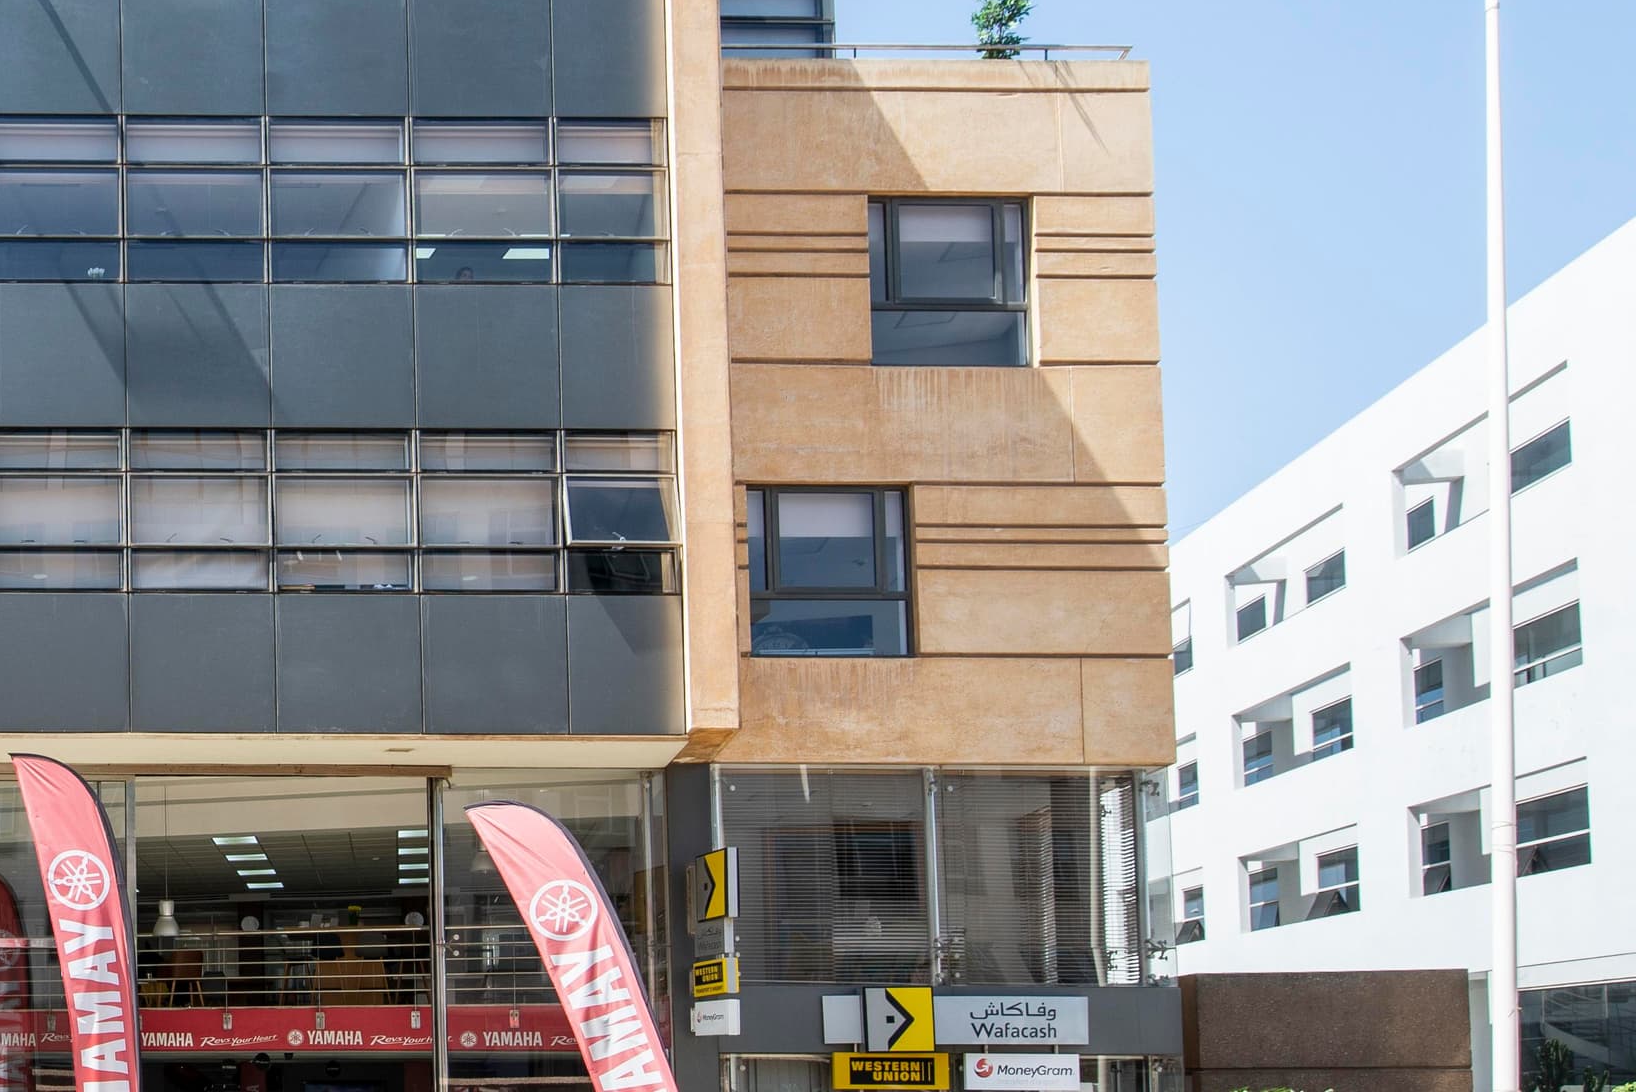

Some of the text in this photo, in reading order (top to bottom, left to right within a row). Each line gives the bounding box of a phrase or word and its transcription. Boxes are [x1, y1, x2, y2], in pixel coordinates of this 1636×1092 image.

[970, 1002, 1056, 1021] وفاكاش
[307, 1030, 363, 1045] YAMAHA
[370, 1034, 404, 1046] Revs
[403, 1036, 427, 1046] Your
[971, 1022, 1057, 1039] Wafacash
[141, 1032, 194, 1047] YAMAHA
[200, 1036, 231, 1047] Revs
[231, 1036, 253, 1046] Your
[483, 1031, 543, 1047] YAMAHA
[851, 1060, 921, 1072] WESTERN
[997, 1064, 1073, 1078] MoneyGram
[872, 1071, 921, 1082] UNION
